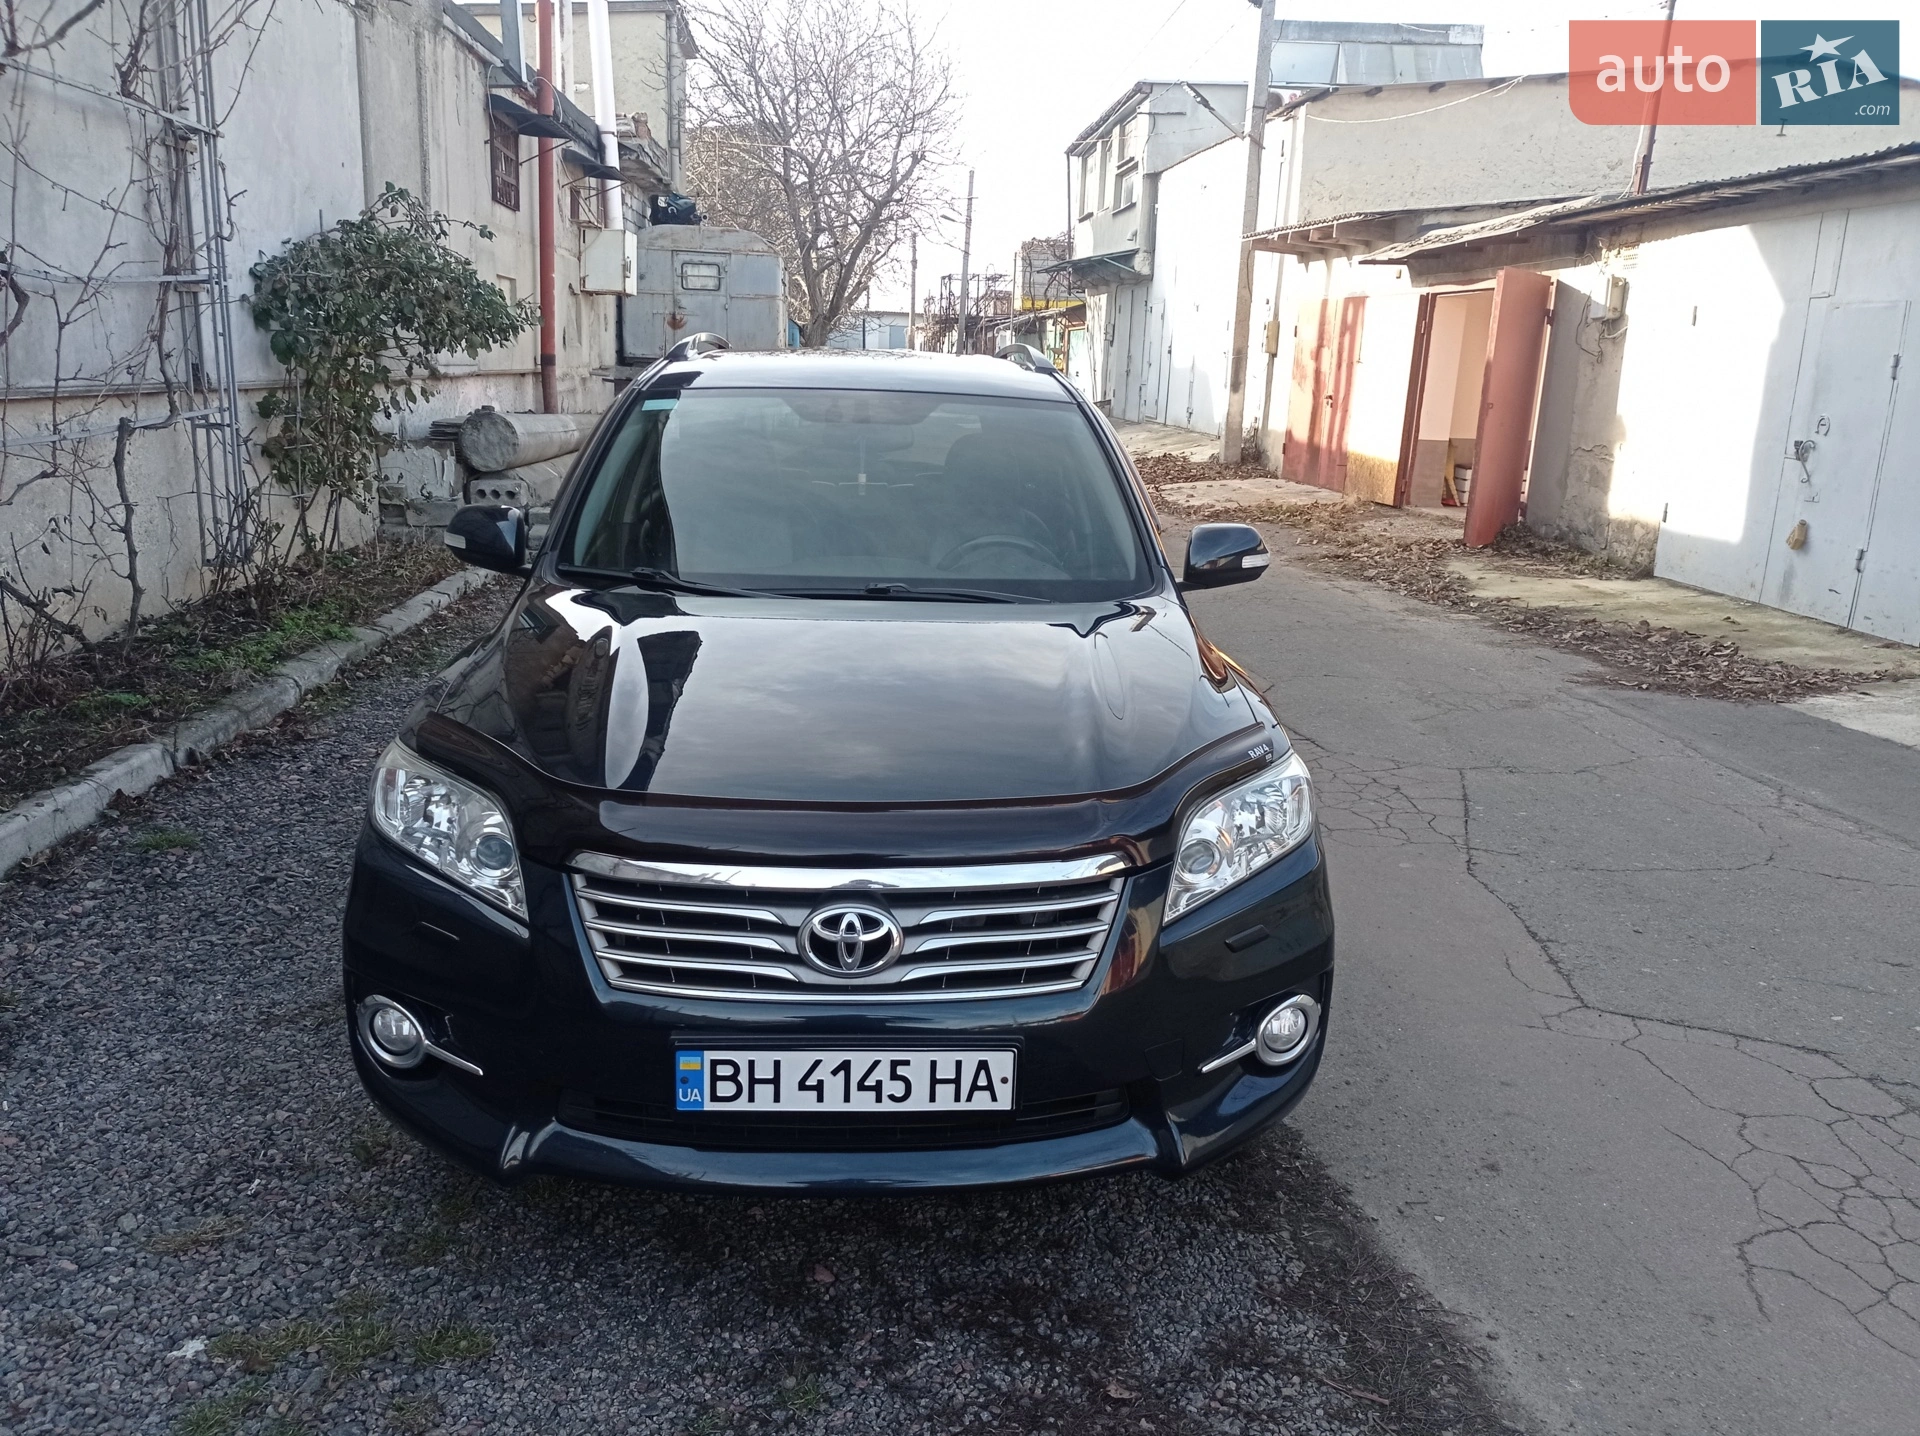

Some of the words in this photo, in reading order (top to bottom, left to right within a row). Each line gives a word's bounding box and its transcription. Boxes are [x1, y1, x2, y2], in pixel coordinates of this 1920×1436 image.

[678, 1088, 702, 1102] UA
[709, 1058, 782, 1103] BH
[797, 1058, 913, 1103] 4145
[929, 1058, 999, 1103] HA
